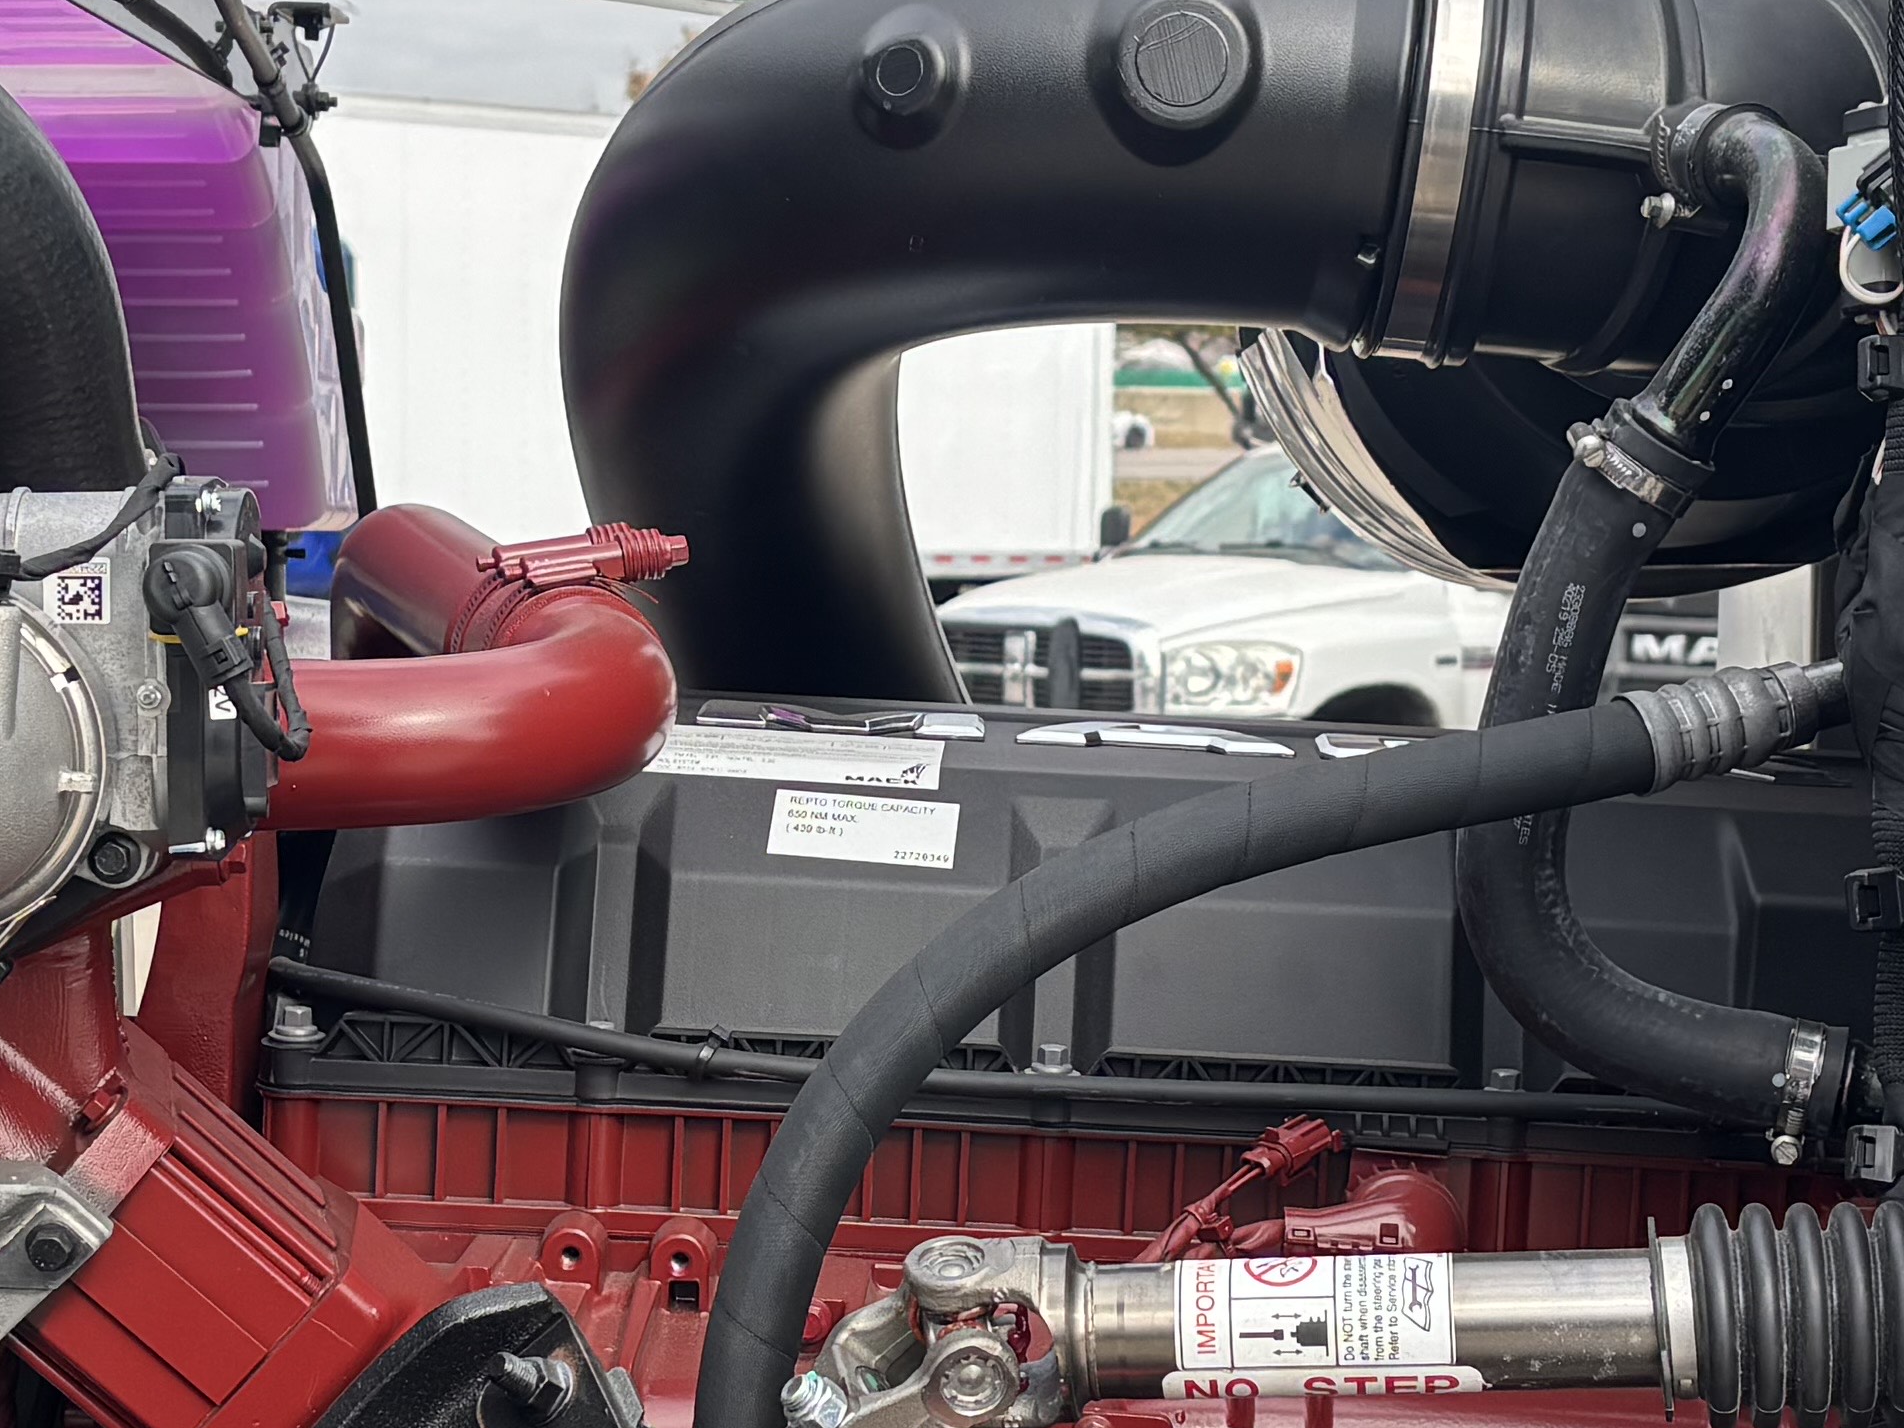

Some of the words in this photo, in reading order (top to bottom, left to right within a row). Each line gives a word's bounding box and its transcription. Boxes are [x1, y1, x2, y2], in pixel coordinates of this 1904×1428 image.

[1631, 633, 1718, 666] MA
[844, 774, 918, 785] MACK
[790, 795, 828, 807] REPTO
[832, 799, 877, 811] TORQUE
[881, 802, 936, 816] CAPACITY
[1343, 1274, 1351, 1287] the
[1343, 1291, 1352, 1312] turn
[1387, 1274, 1397, 1312] Service
[1359, 1301, 1368, 1330] when
[1373, 1315, 1382, 1332] the
[1388, 1316, 1397, 1327] to
[1342, 1316, 1354, 1342] NOT
[1344, 1346, 1355, 1361] Do
[1358, 1335, 1370, 1361] shaft
[1374, 1336, 1384, 1361] from
[1388, 1331, 1399, 1360] Refer
[1183, 1378, 1259, 1399] NO
[1303, 1375, 1460, 1397] STEP
